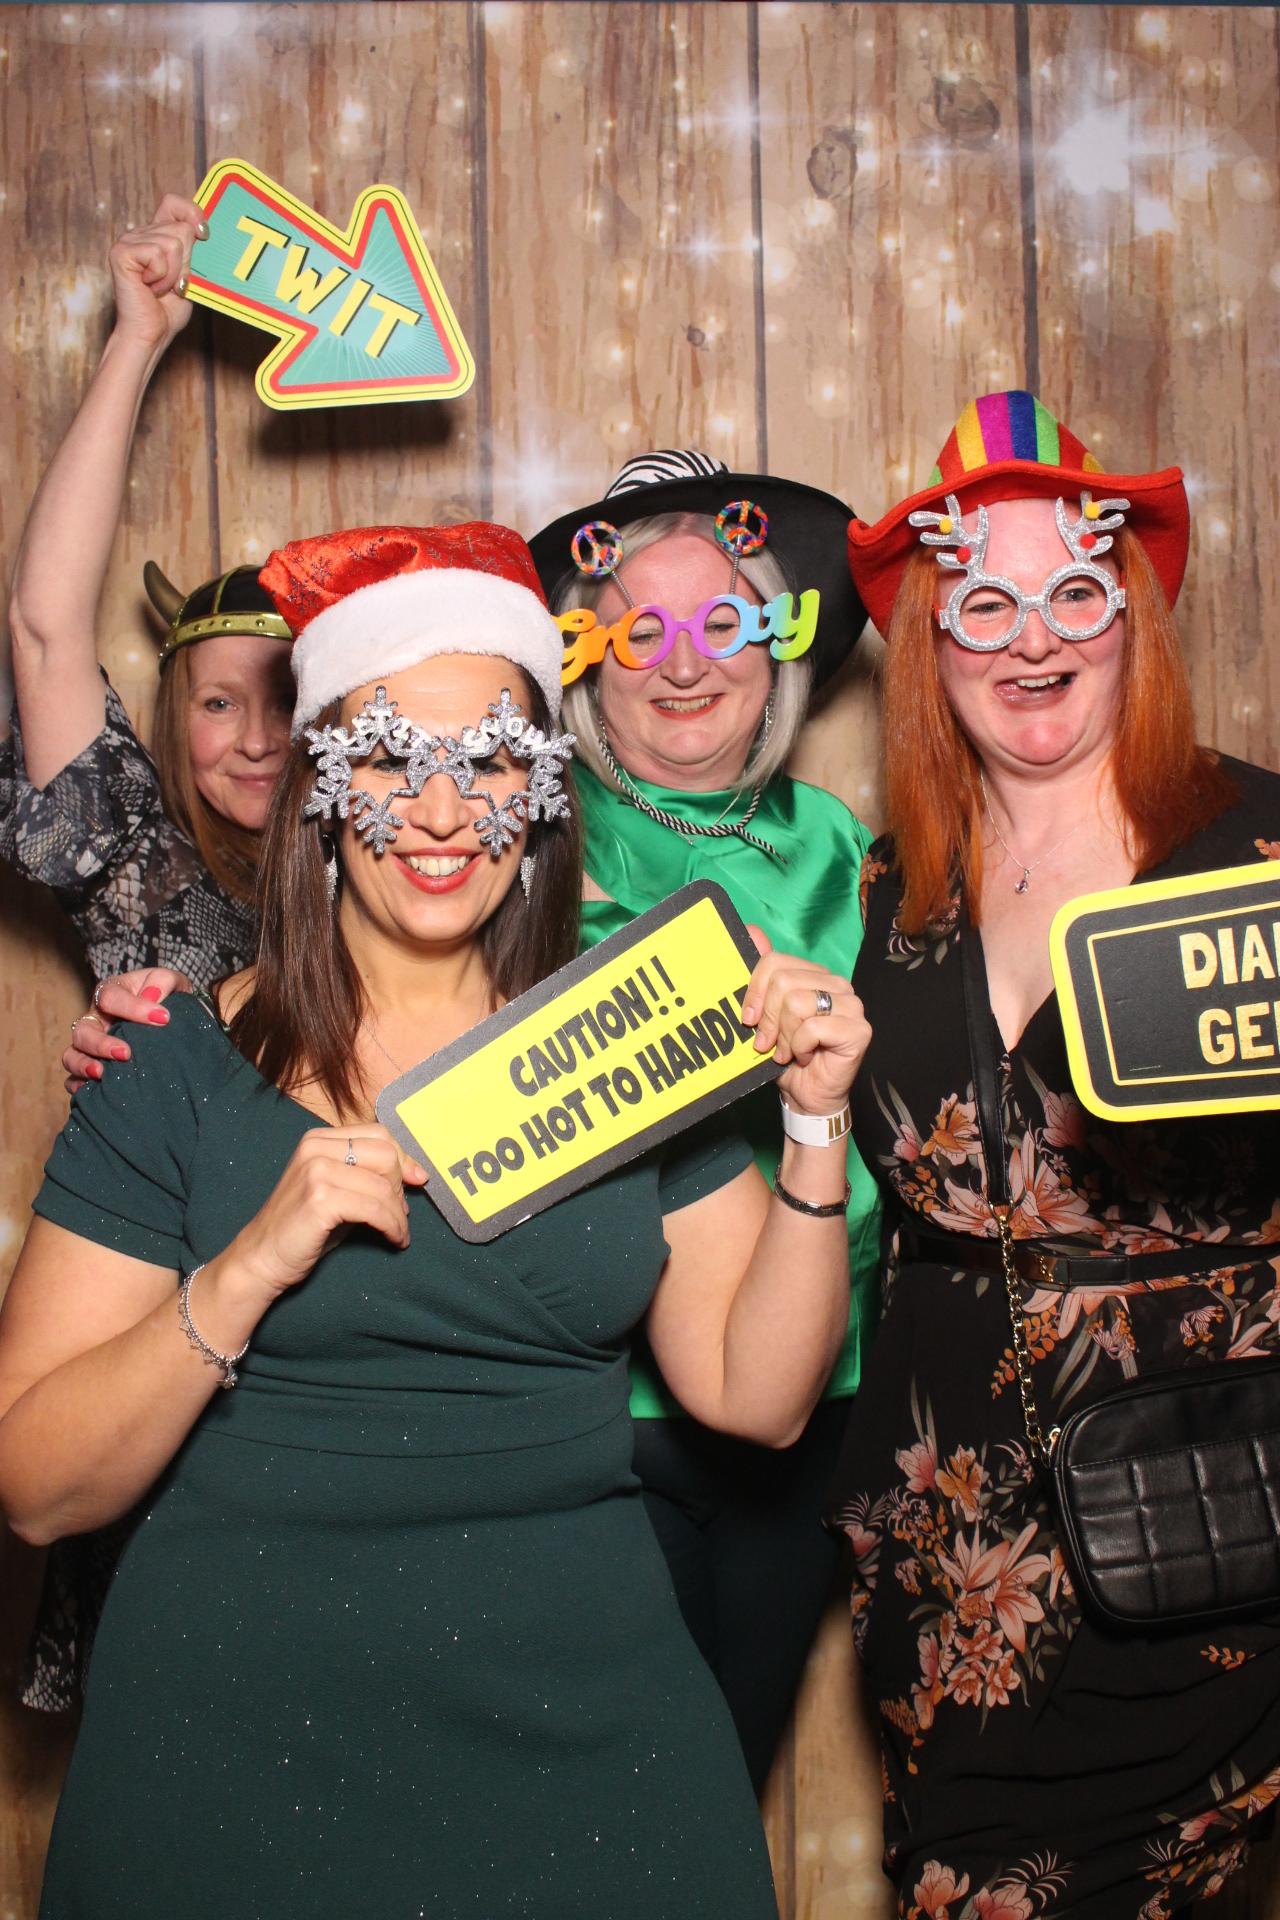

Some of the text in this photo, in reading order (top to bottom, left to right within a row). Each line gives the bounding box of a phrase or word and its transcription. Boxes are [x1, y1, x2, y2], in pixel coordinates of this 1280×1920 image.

[234, 216, 422, 358] TWIT
[509, 955, 686, 1097] CAUTION!!
[1179, 922, 1280, 989] DIA
[448, 984, 756, 1197] TOO HOT TO HANDL
[1198, 1000, 1280, 1065] GE
